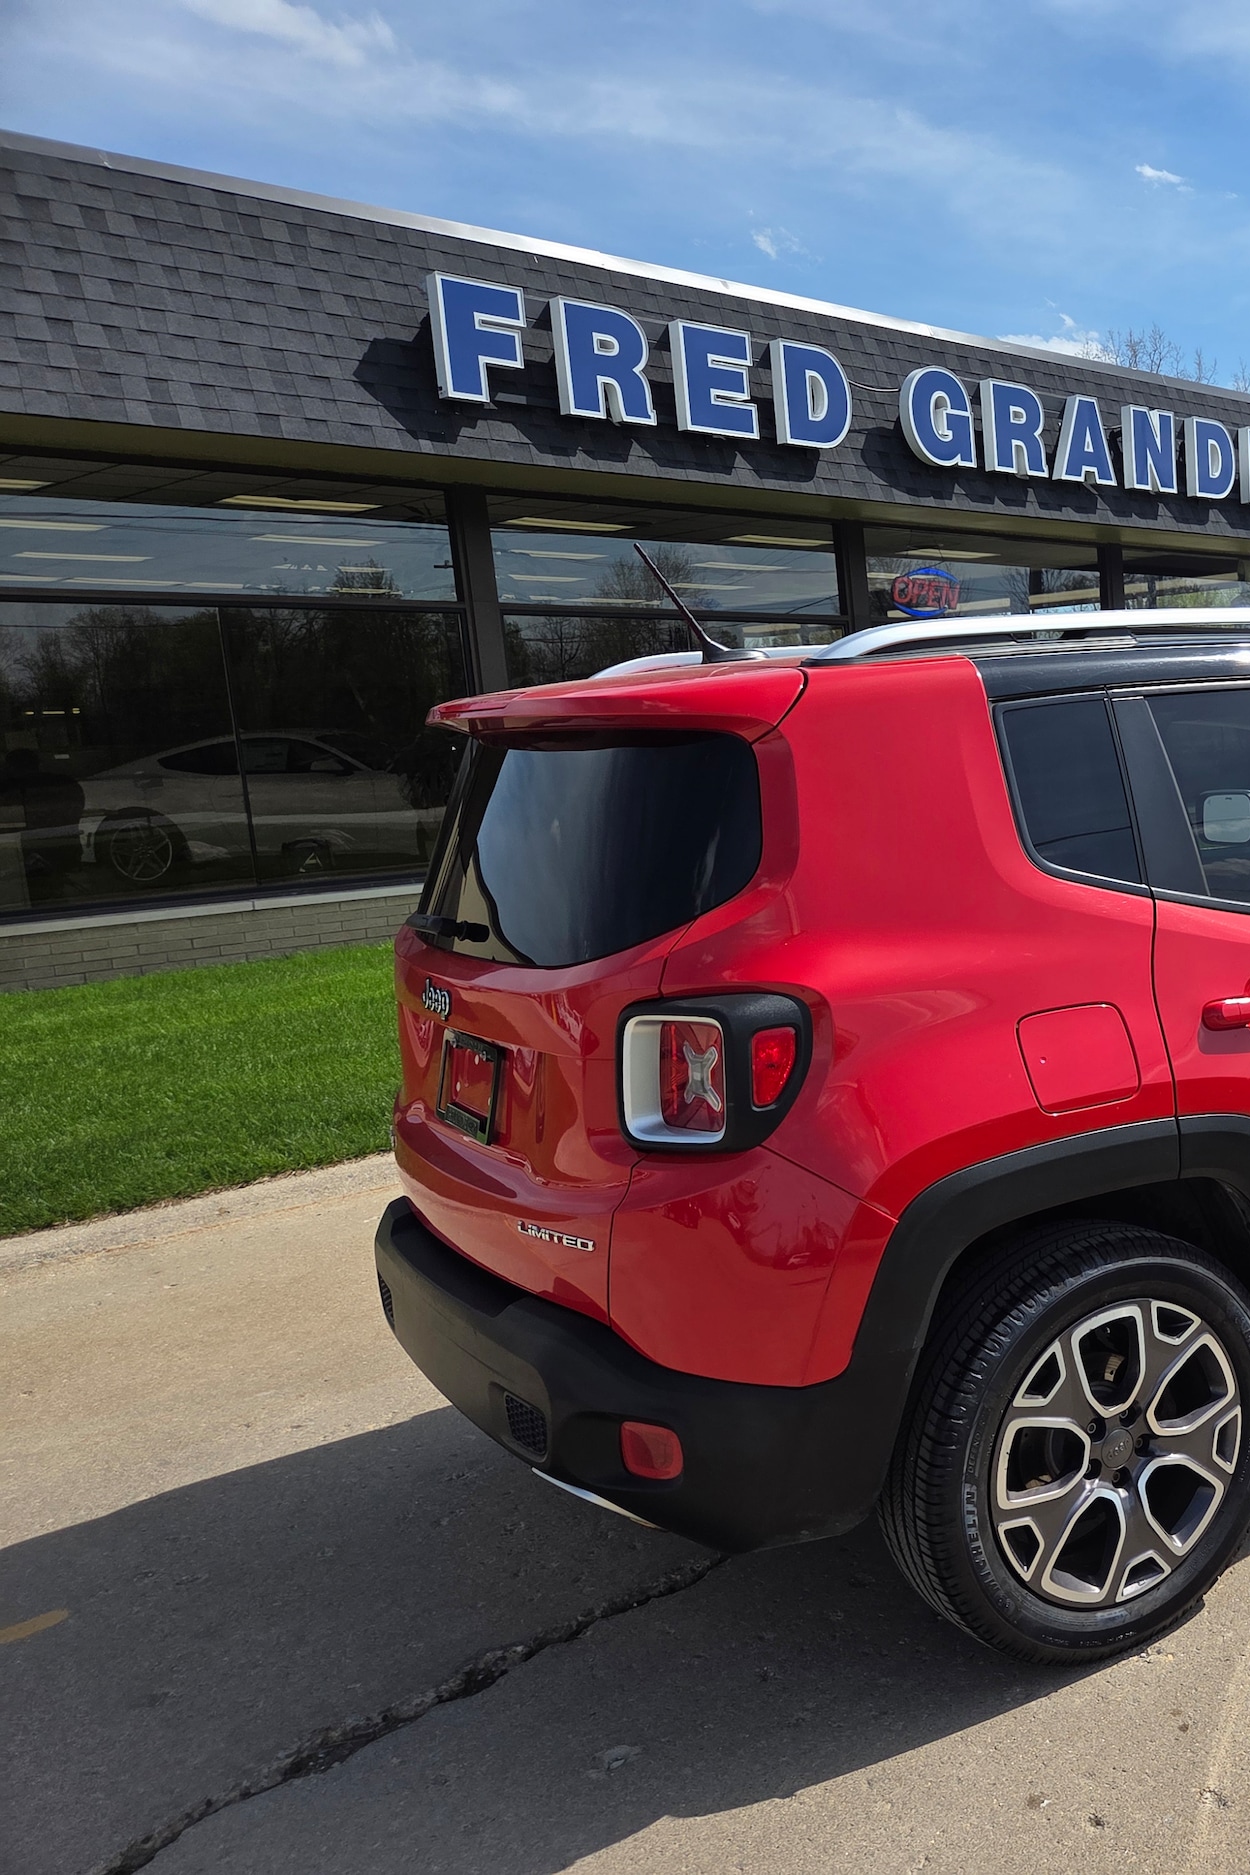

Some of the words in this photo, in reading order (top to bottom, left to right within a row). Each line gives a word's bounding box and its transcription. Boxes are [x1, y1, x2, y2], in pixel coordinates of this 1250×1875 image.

[427, 271, 852, 449] FRED
[893, 576, 960, 609] OPEN
[422, 978, 450, 1020] Jeep
[517, 1220, 595, 1252] LIMITED
[965, 1490, 1000, 1592] MICHELIN
